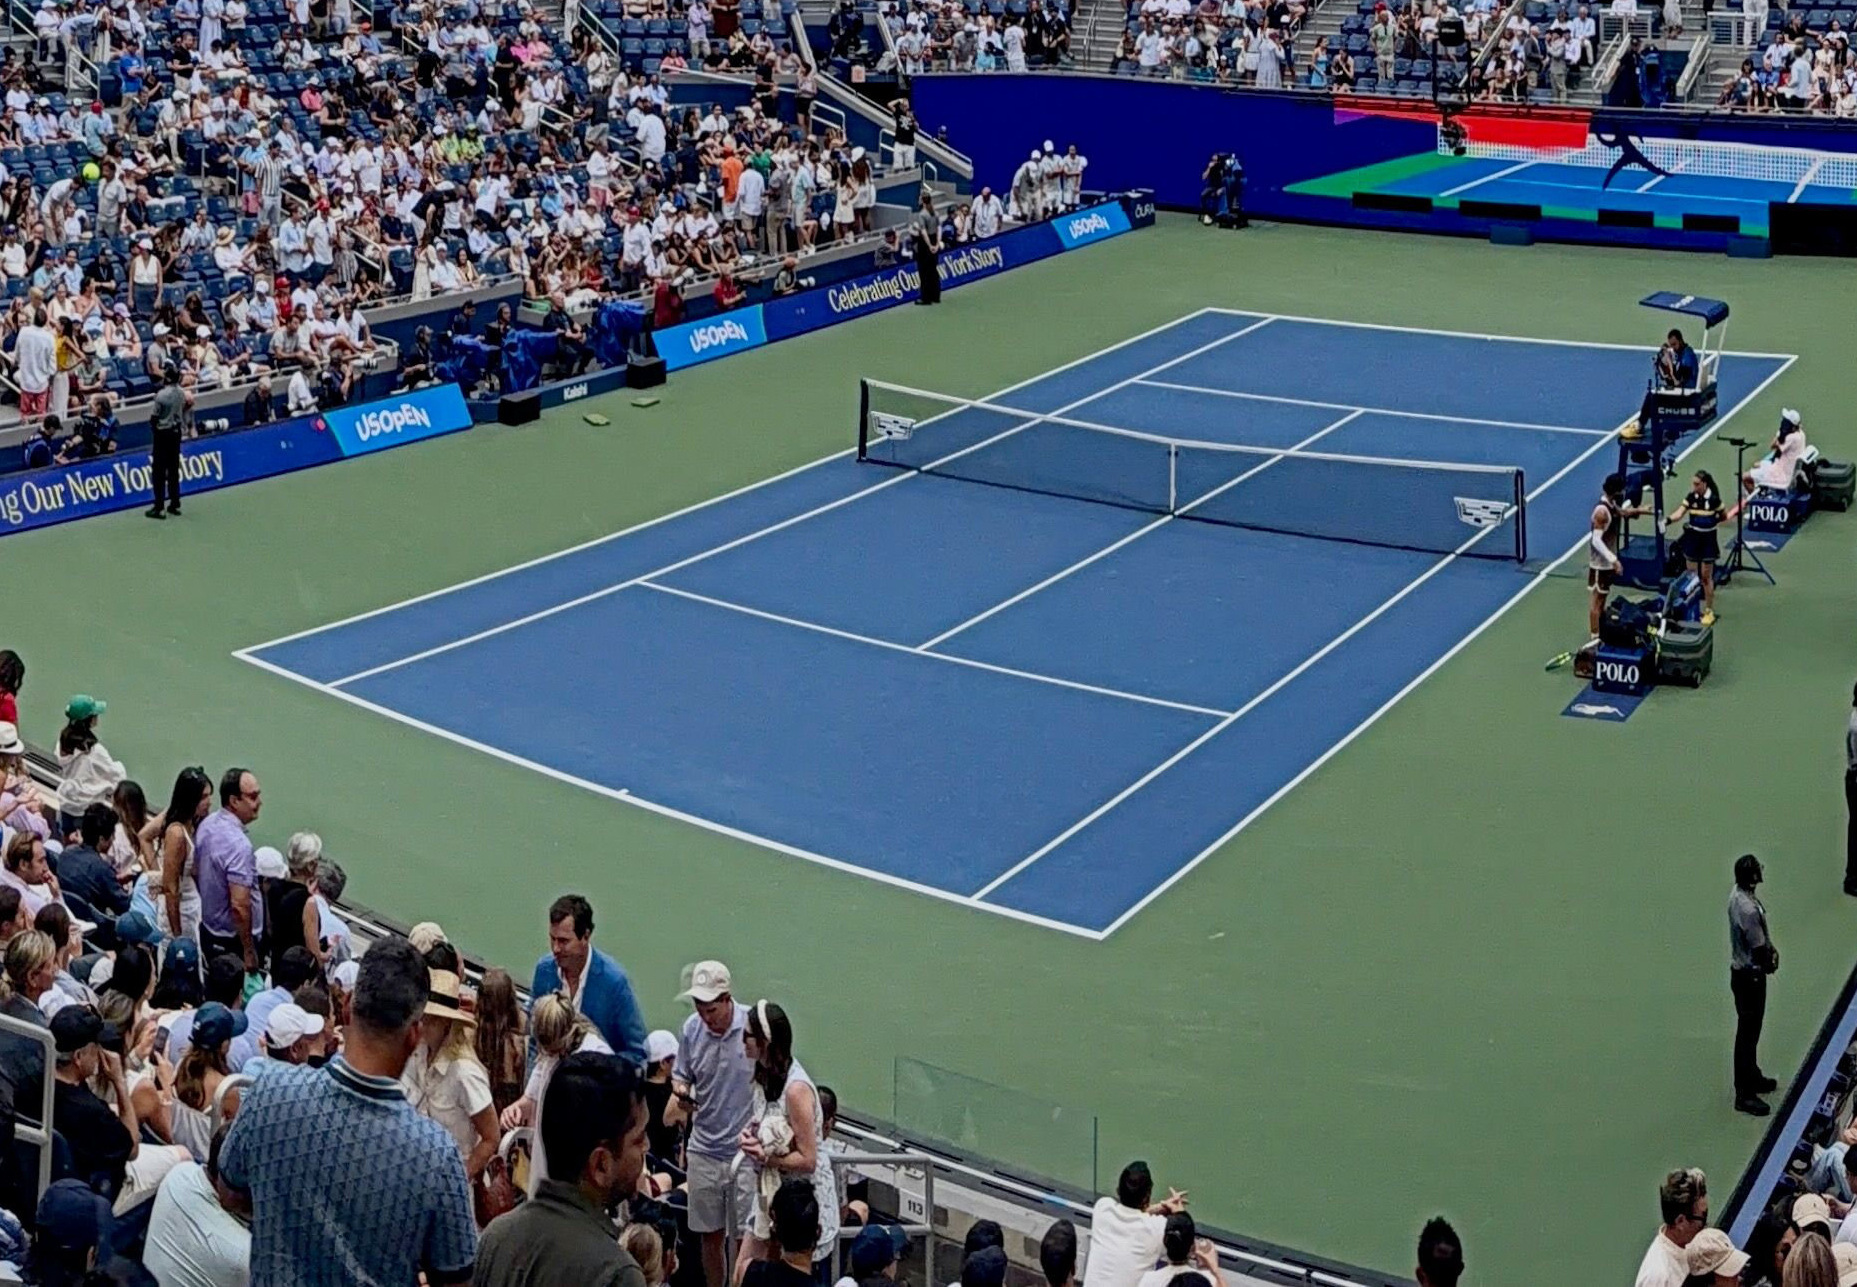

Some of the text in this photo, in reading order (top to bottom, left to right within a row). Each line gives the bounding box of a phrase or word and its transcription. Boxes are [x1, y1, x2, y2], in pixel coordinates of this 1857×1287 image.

[829, 272, 903, 313] Celebrating
[945, 251, 973, 277] York
[973, 247, 1004, 269] Story
[22, 482, 64, 513] Our
[66, 472, 114, 504] New
[114, 456, 154, 494] Yor
[178, 451, 223, 481] tory
[1751, 504, 1789, 523] POLO
[1595, 661, 1640, 684] POLO
[907, 1199, 923, 1216] 113
